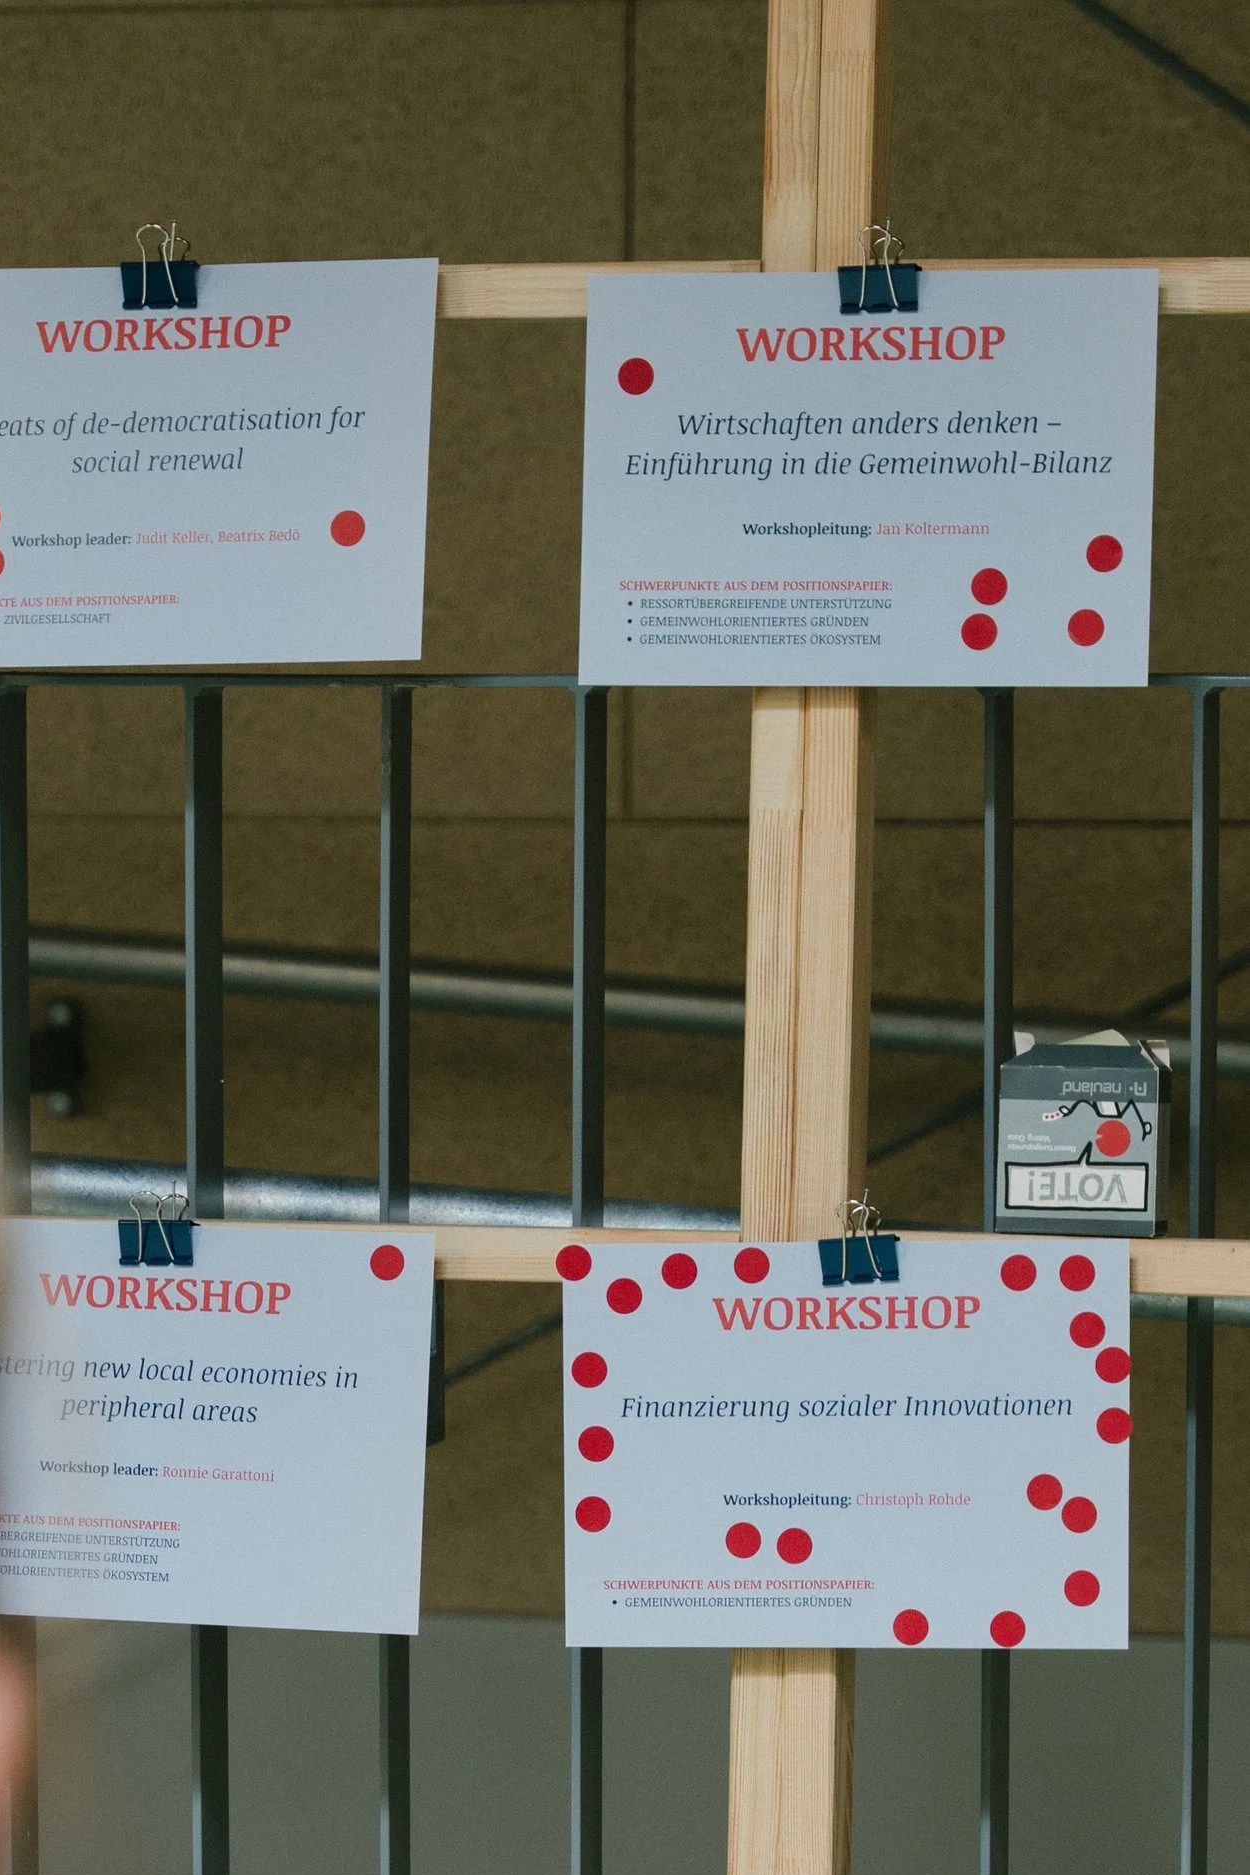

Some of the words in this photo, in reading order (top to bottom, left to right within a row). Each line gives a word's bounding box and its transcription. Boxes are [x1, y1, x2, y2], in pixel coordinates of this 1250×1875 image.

[36, 315, 291, 353] WORKSHOP
[736, 326, 1006, 362] WORKSHOP
[53, 412, 78, 441] of
[82, 407, 321, 434] de-democratisation
[326, 406, 365, 434] for
[678, 412, 843, 441] Wirtschaften
[851, 411, 939, 434] anders
[946, 410, 1038, 434] denken
[72, 449, 140, 473] social
[148, 447, 244, 471] renewal
[625, 452, 772, 481] Einführung
[781, 452, 805, 475] in
[814, 451, 852, 475] die
[859, 450, 1112, 474] Gemeinwohl-Bilanz
[12, 534, 82, 549] Workshop
[86, 531, 131, 546] leader:
[135, 531, 167, 544] Judit
[171, 531, 214, 544] Keller,
[218, 530, 265, 542] Beatrix
[269, 528, 300, 541] Bedö
[742, 522, 871, 538] Workshopleitung:
[875, 523, 900, 536] Jan
[904, 522, 990, 535] Koltermann
[619, 580, 720, 591] SCHWERPUNKTE
[723, 581, 747, 591] AUS
[751, 580, 779, 591] DEM
[782, 580, 892, 591] POSITIONSPAPIER:
[20, 597, 43, 607] AUS
[46, 596, 73, 606] DEM
[76, 594, 179, 606] POSITIONSPAPIER:
[640, 596, 787, 609] RESSORTÜBERGREIFENDE
[791, 597, 893, 609] UNTERSTÜTZUNG
[4, 612, 111, 625] ZIVILGESELLSCHAFT
[639, 616, 806, 627] GEMEINWOHLORIENTIERTES
[810, 615, 869, 627] GRÜNDEN
[639, 634, 806, 645] GEMEINWOHLORIENTIERTES
[810, 632, 881, 645] ÖKOSYSTEM
[1063, 1080, 1122, 1096] neuland
[1028, 1171, 1127, 1203] VOTE!
[40, 1274, 291, 1314] WORKSHOP
[713, 1296, 980, 1330] WORKSHOP
[84, 1361, 130, 1380] new
[139, 1357, 194, 1381] local
[201, 1364, 327, 1387] economies
[335, 1366, 358, 1388] in
[60, 1395, 185, 1422] peripheral
[192, 1404, 257, 1423] areas
[621, 1395, 790, 1423] Finanzierung
[798, 1394, 897, 1417] sozialer
[905, 1394, 1072, 1416] Innovationen
[39, 1460, 109, 1477] Workshop
[112, 1462, 158, 1477] leader:
[162, 1466, 208, 1479] Ronnie
[212, 1467, 275, 1482] Garattoni
[724, 1493, 851, 1509] Workshopleitung:
[856, 1492, 924, 1508] Christoph
[928, 1492, 971, 1506] Rohde
[23, 1515, 45, 1524] AUS
[48, 1516, 74, 1526] DEM
[78, 1517, 181, 1531] POSITIONSPAPIER:
[85, 1534, 180, 1549] UNTERSTÜTZUNG
[103, 1551, 158, 1565] GRÜNDEN
[102, 1568, 169, 1582] ÖKOSYSTEM
[603, 1579, 703, 1590] SCHWERPUNKTE
[707, 1579, 731, 1590] AUS
[734, 1579, 762, 1590] DEM
[765, 1579, 875, 1590] POSITIONSPAPIER:
[625, 1597, 791, 1608] GEMEINWOHLORIENTIERTES
[794, 1595, 852, 1608] GRÜNDEN
